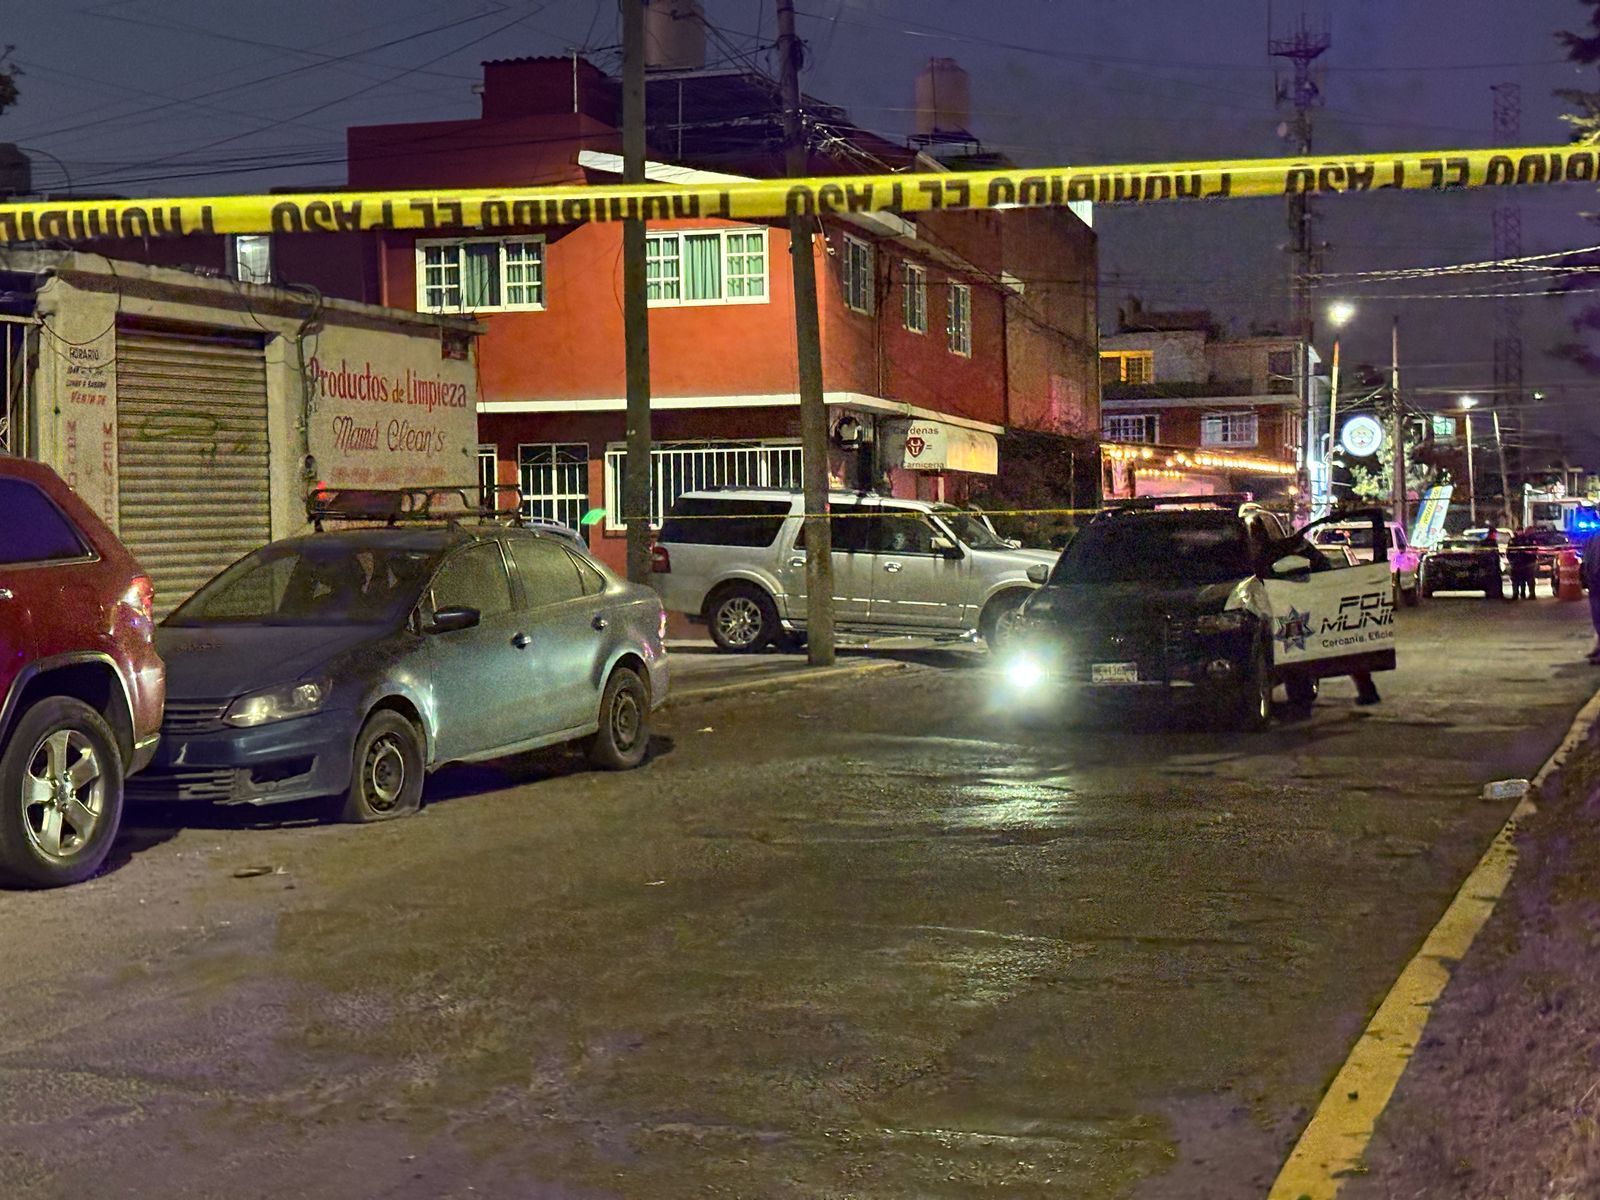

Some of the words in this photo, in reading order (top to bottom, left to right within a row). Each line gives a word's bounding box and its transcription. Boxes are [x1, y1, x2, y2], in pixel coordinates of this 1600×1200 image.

[310, 357, 388, 402] Productos
[392, 378, 404, 403] de
[407, 368, 467, 412] Limpieza
